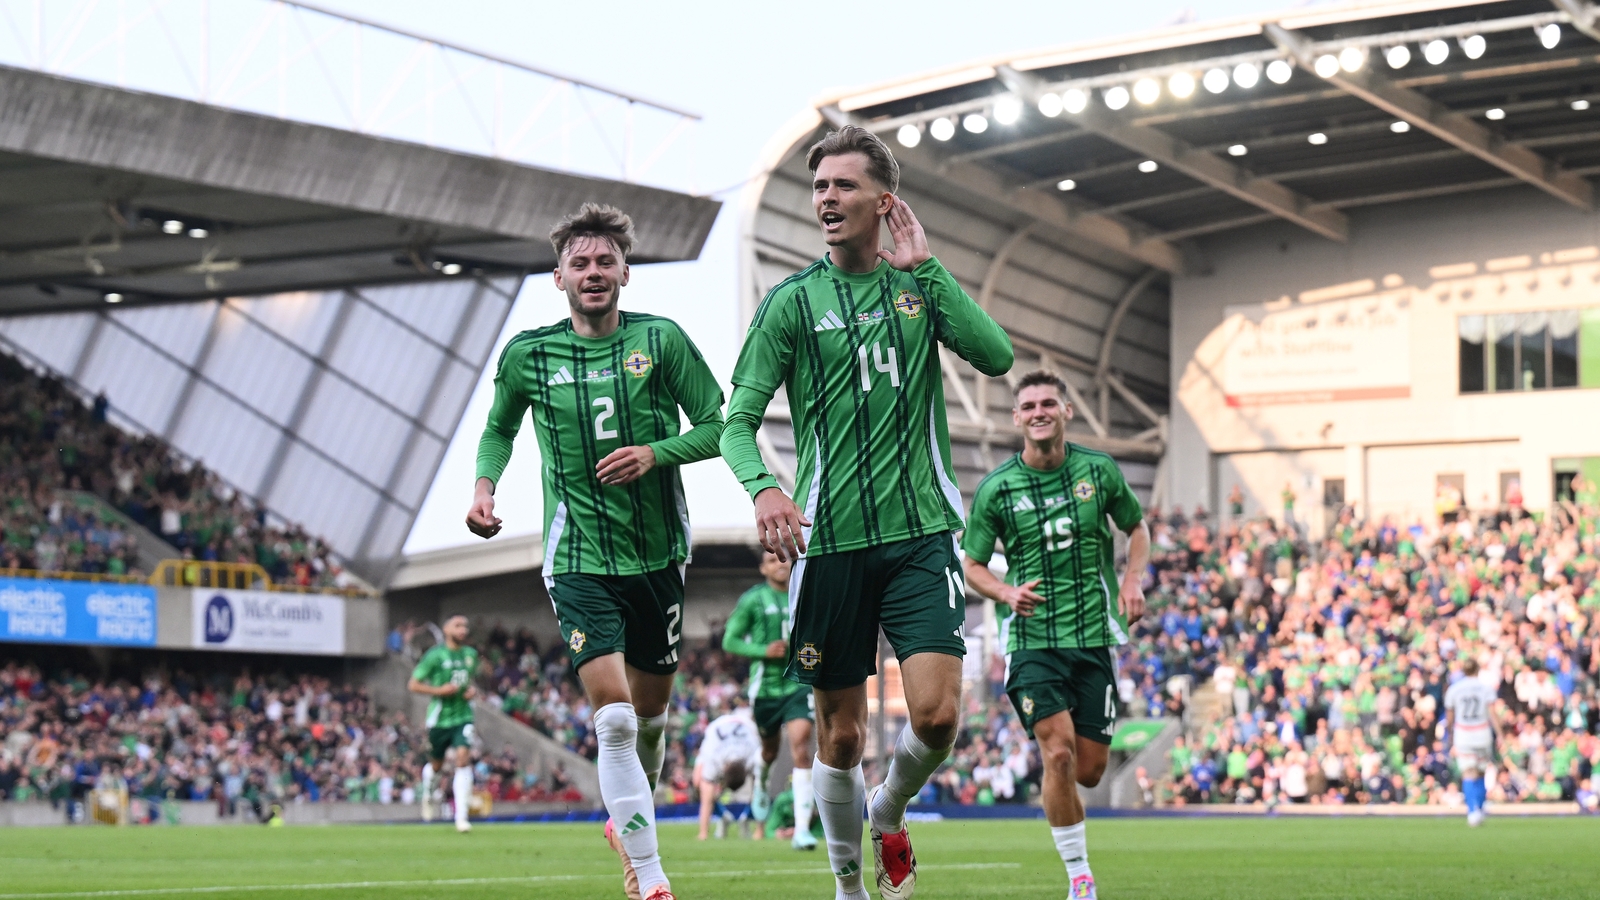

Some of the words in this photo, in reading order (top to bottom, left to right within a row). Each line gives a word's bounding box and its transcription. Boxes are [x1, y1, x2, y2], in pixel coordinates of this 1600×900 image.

[858, 341, 900, 391] 14
[592, 396, 618, 440] 2
[1044, 517, 1074, 551] 15
[666, 603, 680, 646] 2
[1461, 696, 1481, 720] 22
